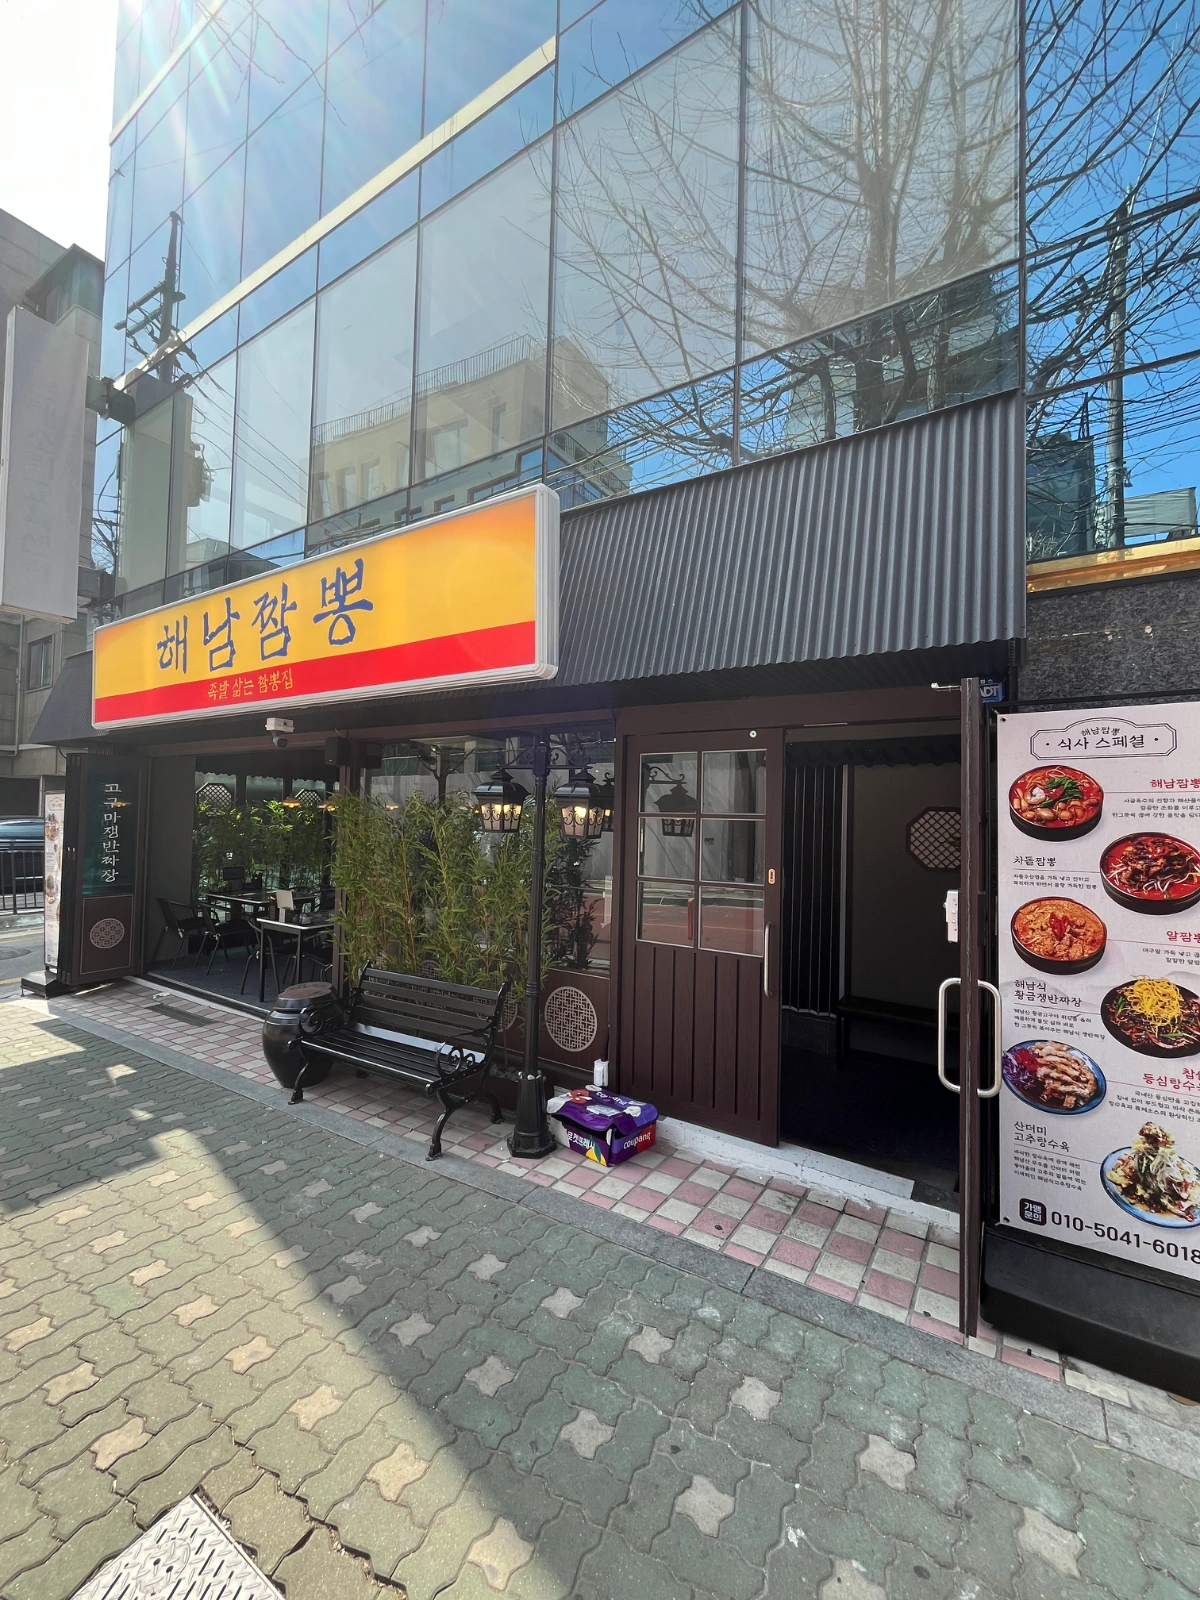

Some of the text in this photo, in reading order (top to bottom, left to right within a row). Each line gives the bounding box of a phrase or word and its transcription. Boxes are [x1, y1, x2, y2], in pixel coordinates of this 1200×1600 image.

[156, 557, 374, 674] 해남짬뽕
[207, 668, 293, 702] 족발 삶는 짬뽕집
[1057, 737, 1089, 751] 식사
[1149, 778, 1200, 789] 해남짬뽕
[101, 783, 123, 883] 고구마쟁반짜장
[1013, 856, 1057, 867] 차돌짬뽕
[1014, 979, 1046, 992] 해남식
[1014, 990, 1082, 1008] 황금쟁반짜장
[1014, 1121, 1047, 1136] 산더미
[623, 1131, 651, 1150] coupang
[1014, 1132, 1070, 1152] 고추탕수육
[1024, 1202, 1042, 1214] 가맹
[1051, 1211, 1200, 1265] 010-5041-6018
